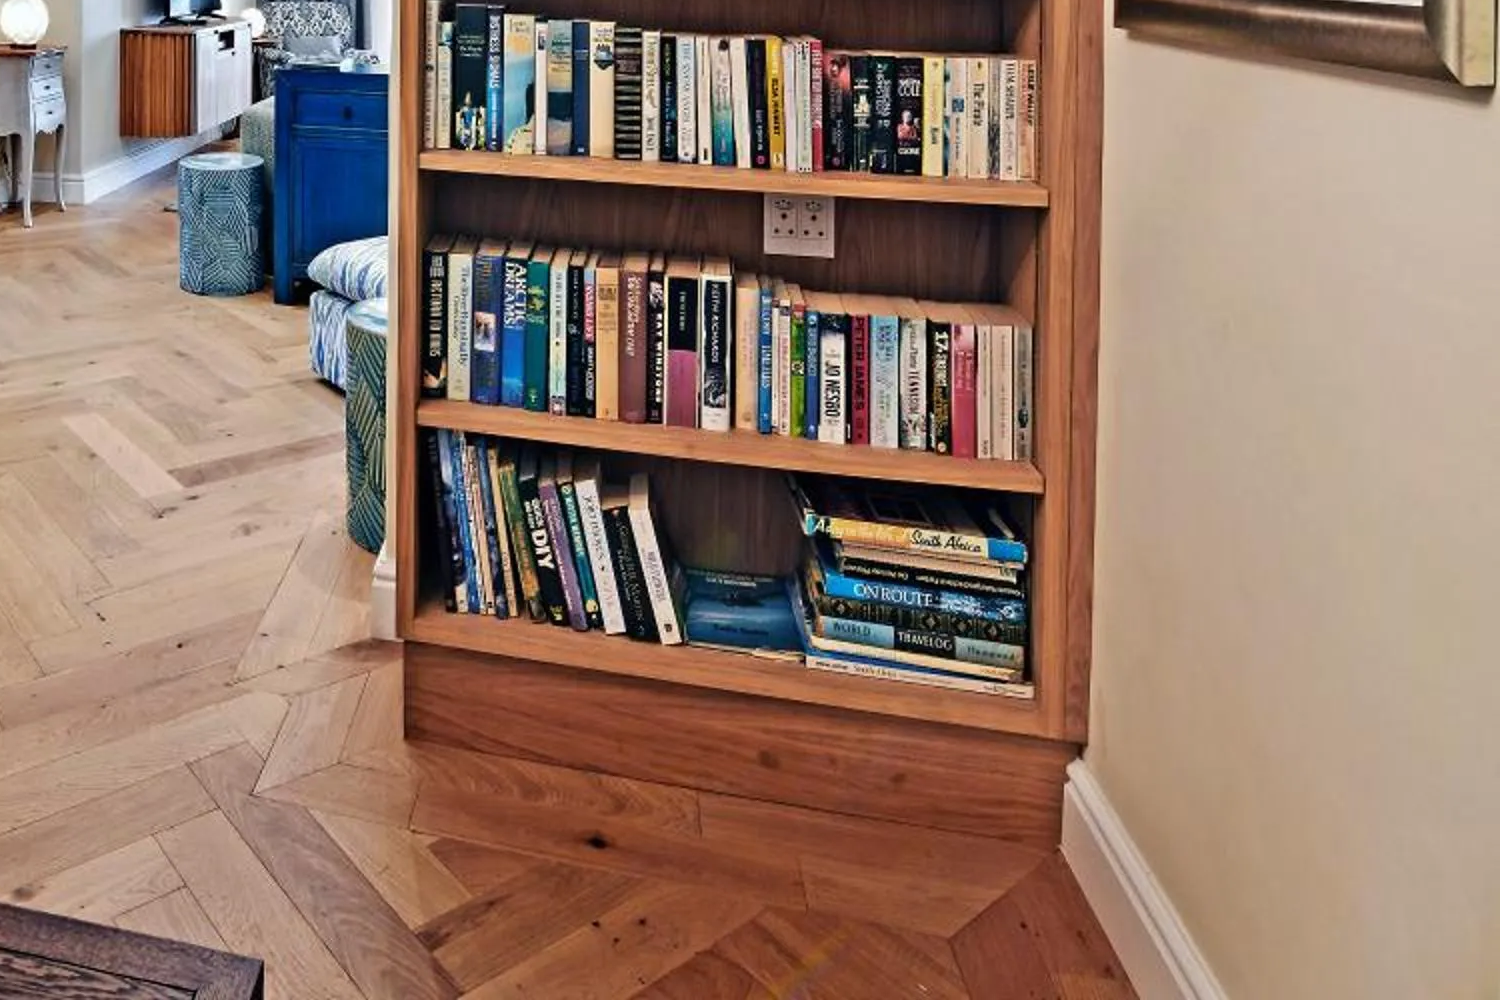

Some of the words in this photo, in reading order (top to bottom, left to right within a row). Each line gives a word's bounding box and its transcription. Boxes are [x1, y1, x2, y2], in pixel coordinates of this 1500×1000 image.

[503, 262, 515, 325] DREAMS
[514, 263, 527, 323] ARCTIC
[710, 284, 719, 312] KEITH
[710, 315, 719, 363] RICHARDS
[855, 317, 865, 360] PETER
[655, 341, 663, 402] WINSTONE
[825, 362, 841, 376] JO
[855, 365, 865, 409] JAMES
[530, 529, 554, 568] DIY
[911, 529, 942, 548] South
[944, 535, 982, 553] Africa
[854, 583, 877, 598] ON
[881, 587, 933, 607] ROUTE
[898, 631, 953, 651] TRAVELOG
